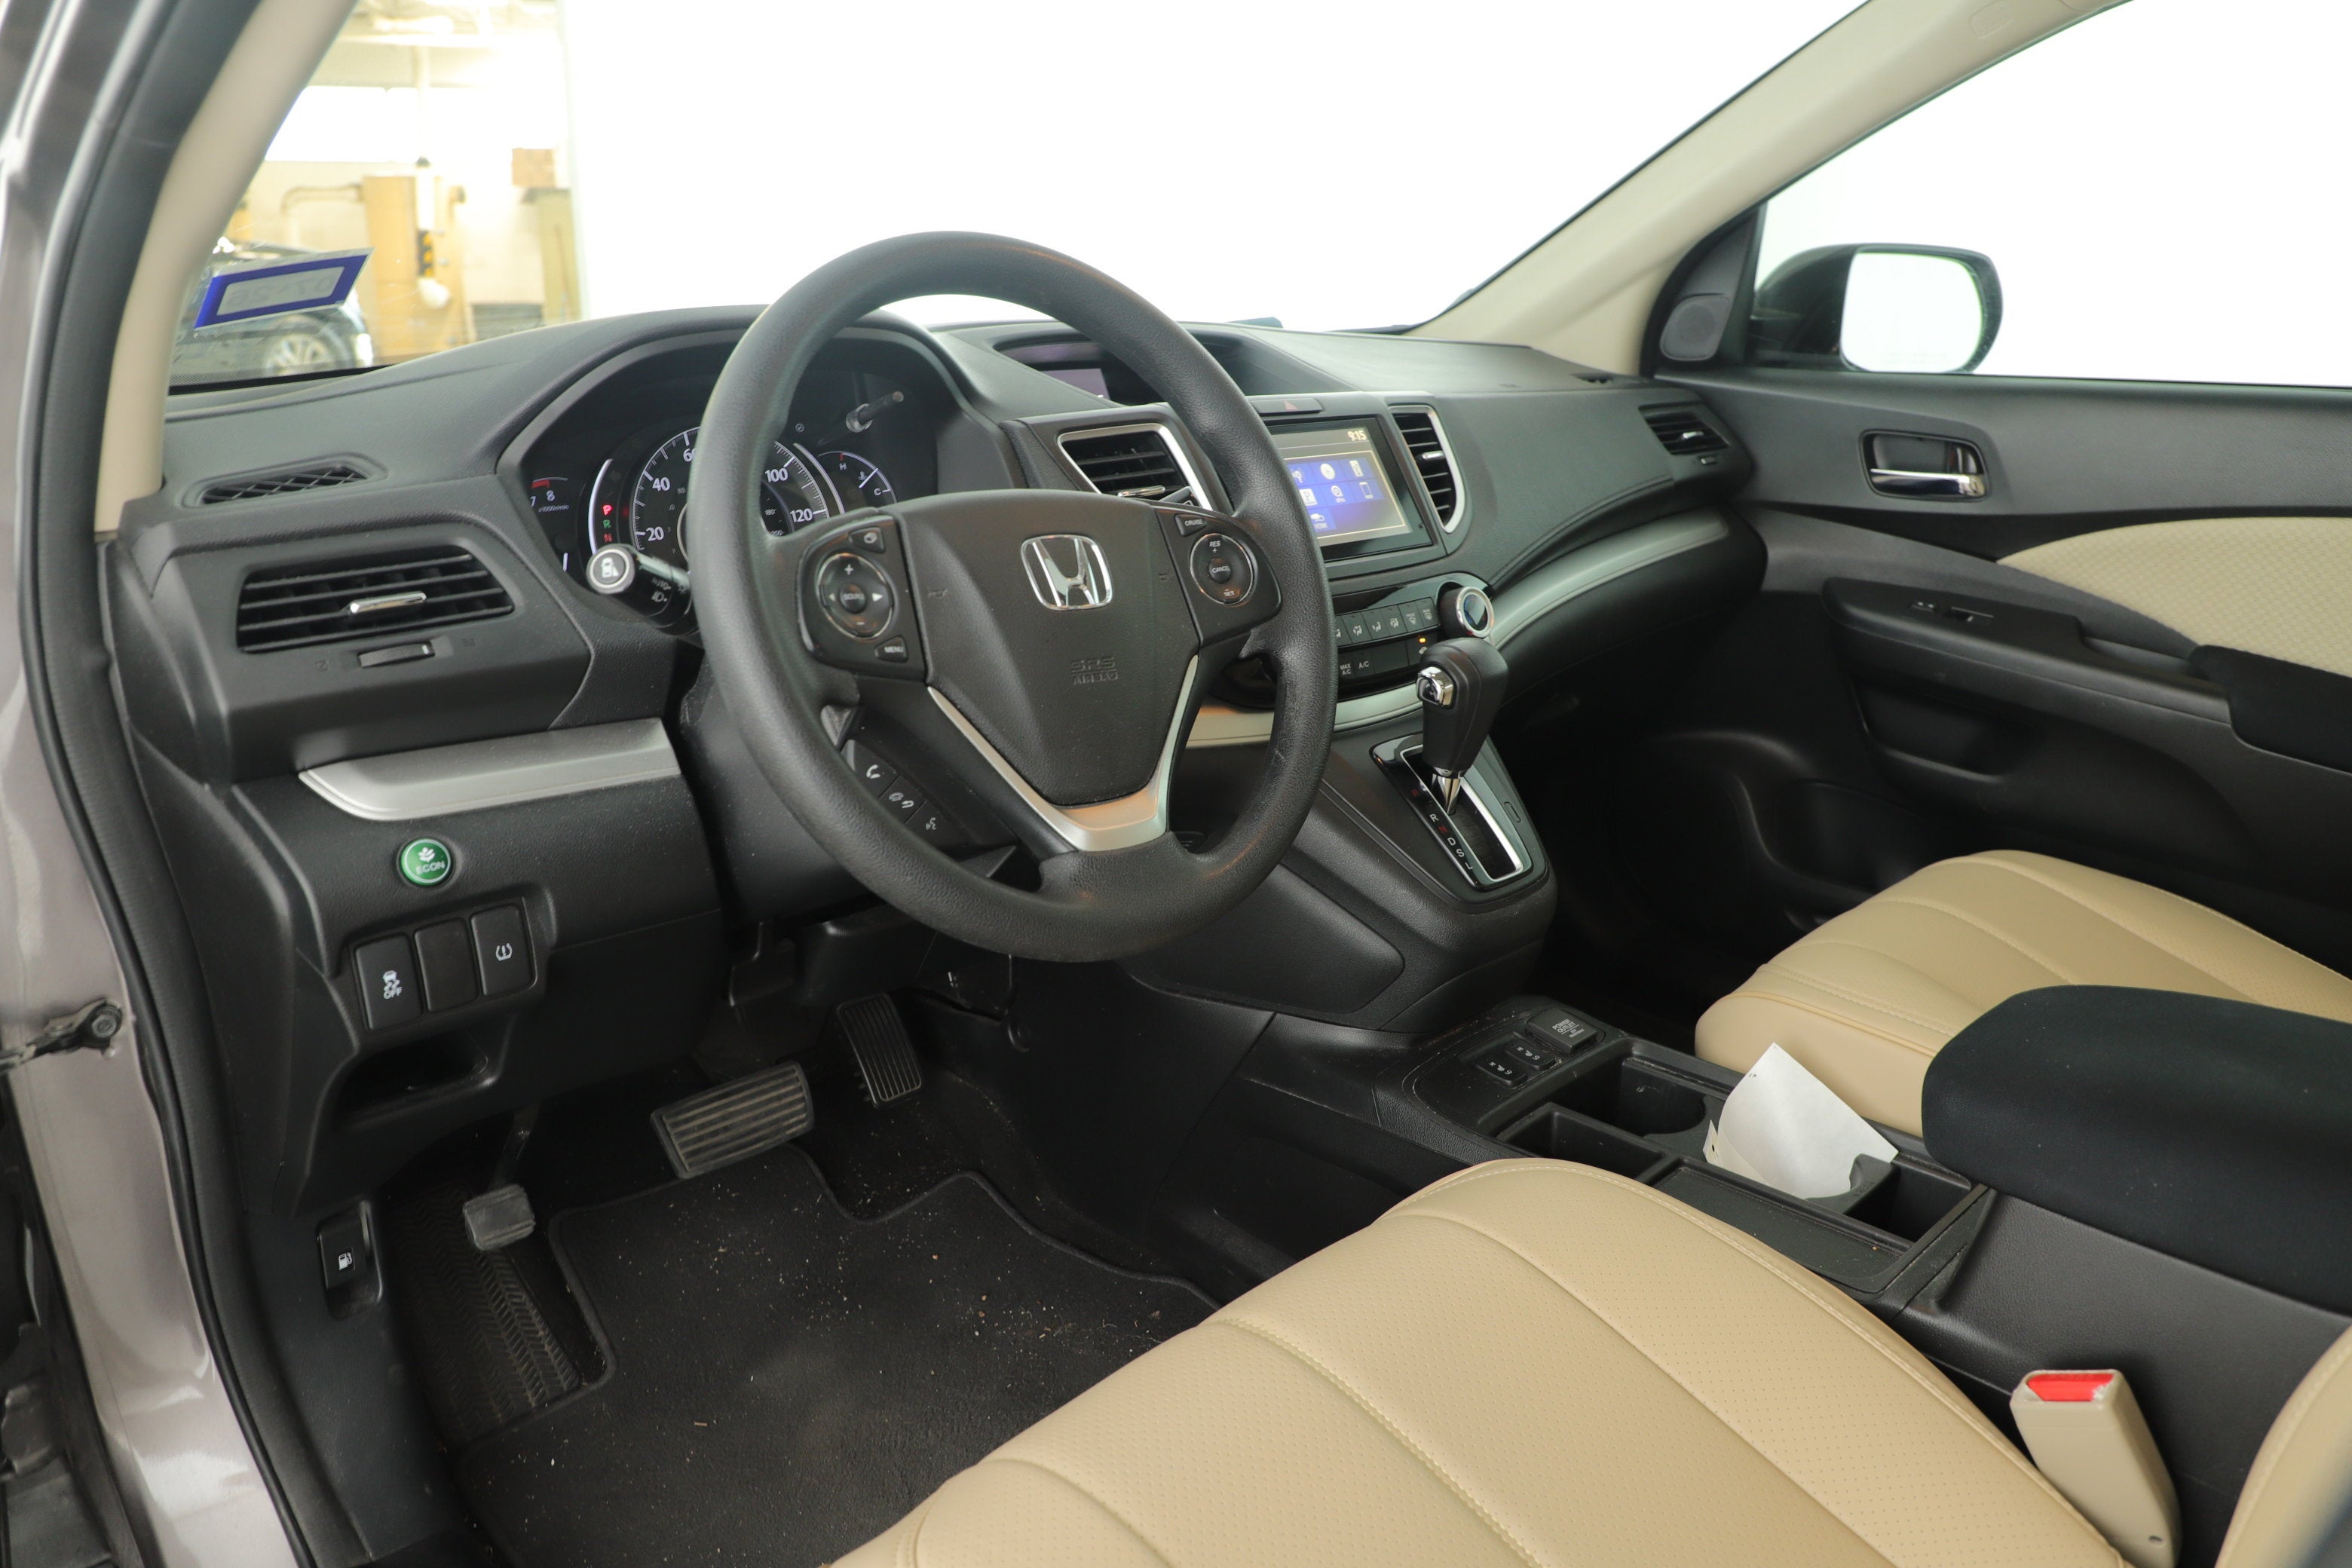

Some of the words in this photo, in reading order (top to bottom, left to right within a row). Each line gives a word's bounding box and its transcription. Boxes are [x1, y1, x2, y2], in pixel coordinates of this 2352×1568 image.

[1347, 430, 1367, 441] 9:15
[764, 467, 789, 482] 100
[652, 476, 671, 492] 40
[546, 490, 556, 501] 8
[530, 496, 536, 507] 7
[602, 504, 612, 516] P
[790, 508, 813, 522] 120
[603, 519, 611, 528] R
[645, 526, 664, 541] 20
[1358, 660, 1369, 669] A/C
[1429, 813, 1439, 822] R
[1447, 837, 1456, 846] D
[1456, 848, 1465, 858] S
[416, 861, 445, 874] ECON
[1465, 862, 1473, 870] L
[383, 986, 403, 999] OFF
[1551, 1018, 1571, 1030] POWER
[1557, 1021, 1576, 1033] OUTLET
